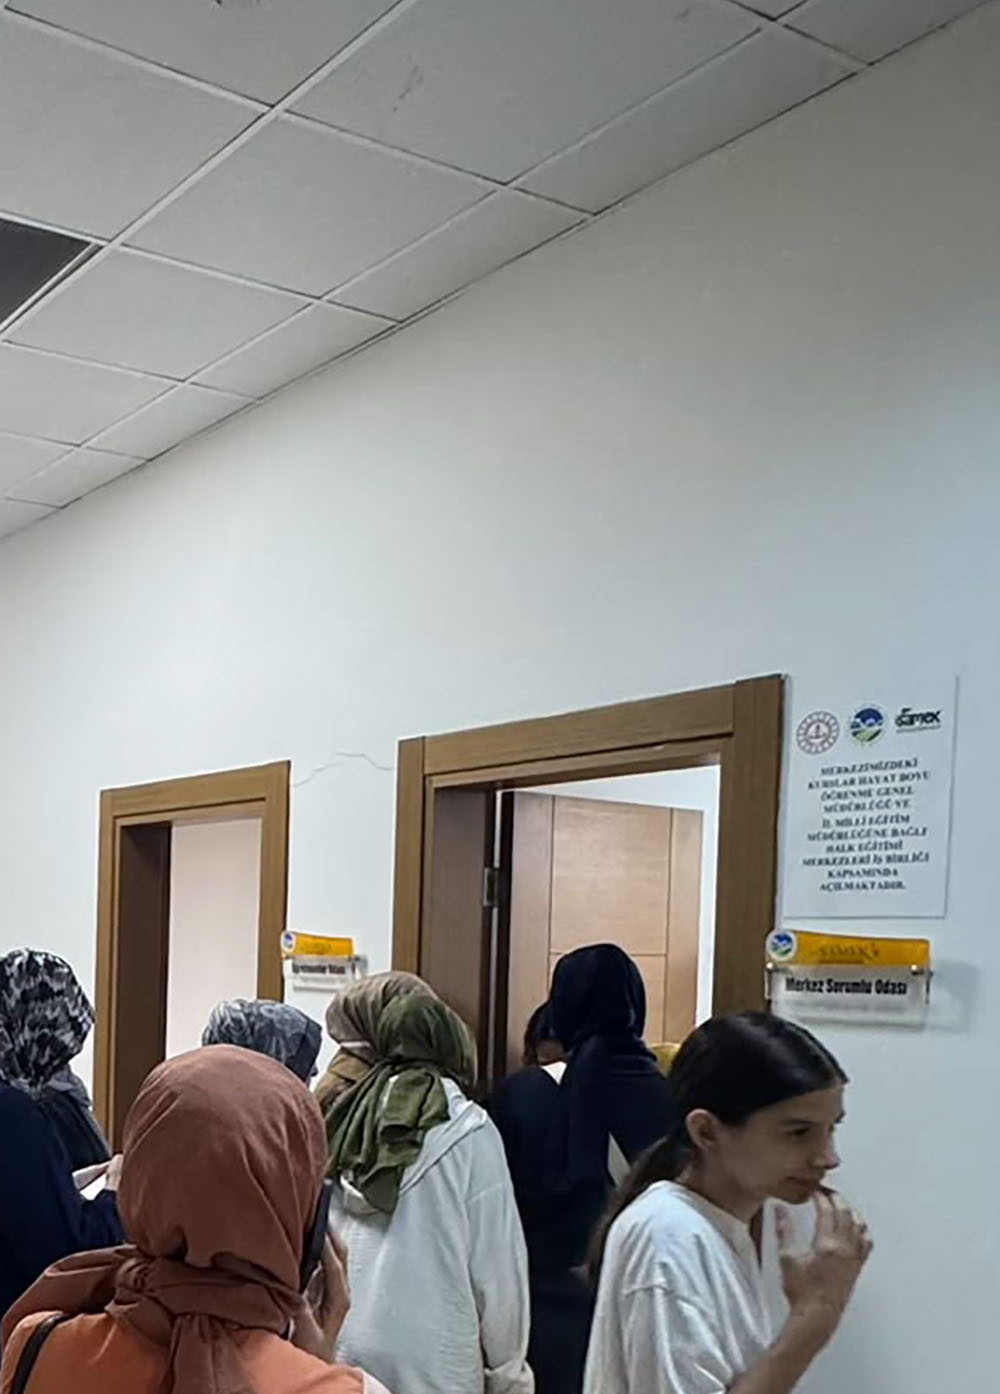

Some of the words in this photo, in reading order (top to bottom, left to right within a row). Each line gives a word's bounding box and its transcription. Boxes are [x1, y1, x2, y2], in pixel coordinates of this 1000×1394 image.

[808, 778, 856, 790] KURSLAR
[858, 774, 896, 786] HAYAT
[899, 770, 929, 782] BOYU
[875, 786, 914, 796] GENEL
[895, 799, 910, 808] VE
[826, 843, 855, 853] HALK
[785, 977, 824, 993] Merkez
[826, 978, 873, 995] Sorumlu
[874, 979, 907, 996] Odası
